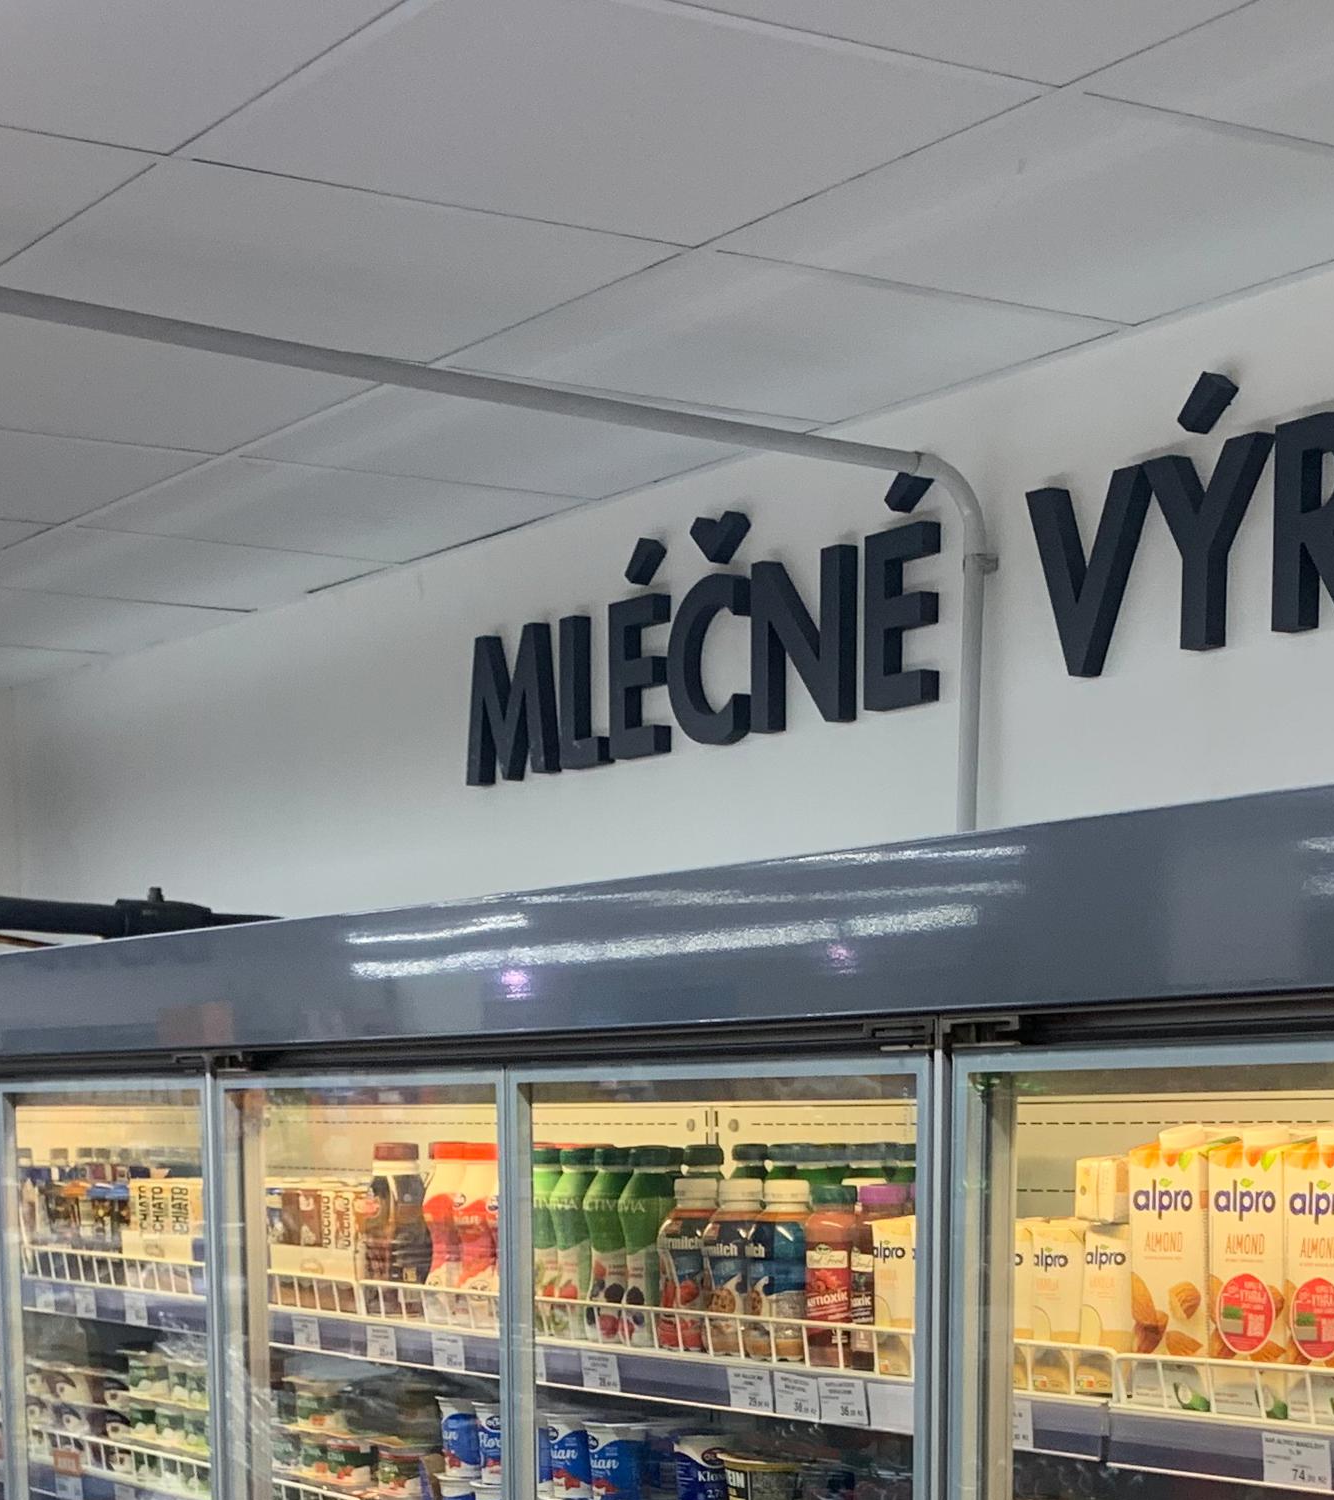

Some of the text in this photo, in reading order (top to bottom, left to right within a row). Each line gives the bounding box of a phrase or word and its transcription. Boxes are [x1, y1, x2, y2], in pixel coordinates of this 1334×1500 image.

[467, 474, 942, 785] MLÉČNÉ
[1133, 1179, 1193, 1220] alpro
[1213, 1179, 1277, 1221] alpro
[1085, 1244, 1127, 1272] alpro
[1143, 1231, 1183, 1253] ALMOND
[1225, 1233, 1265, 1255] ALMOND
